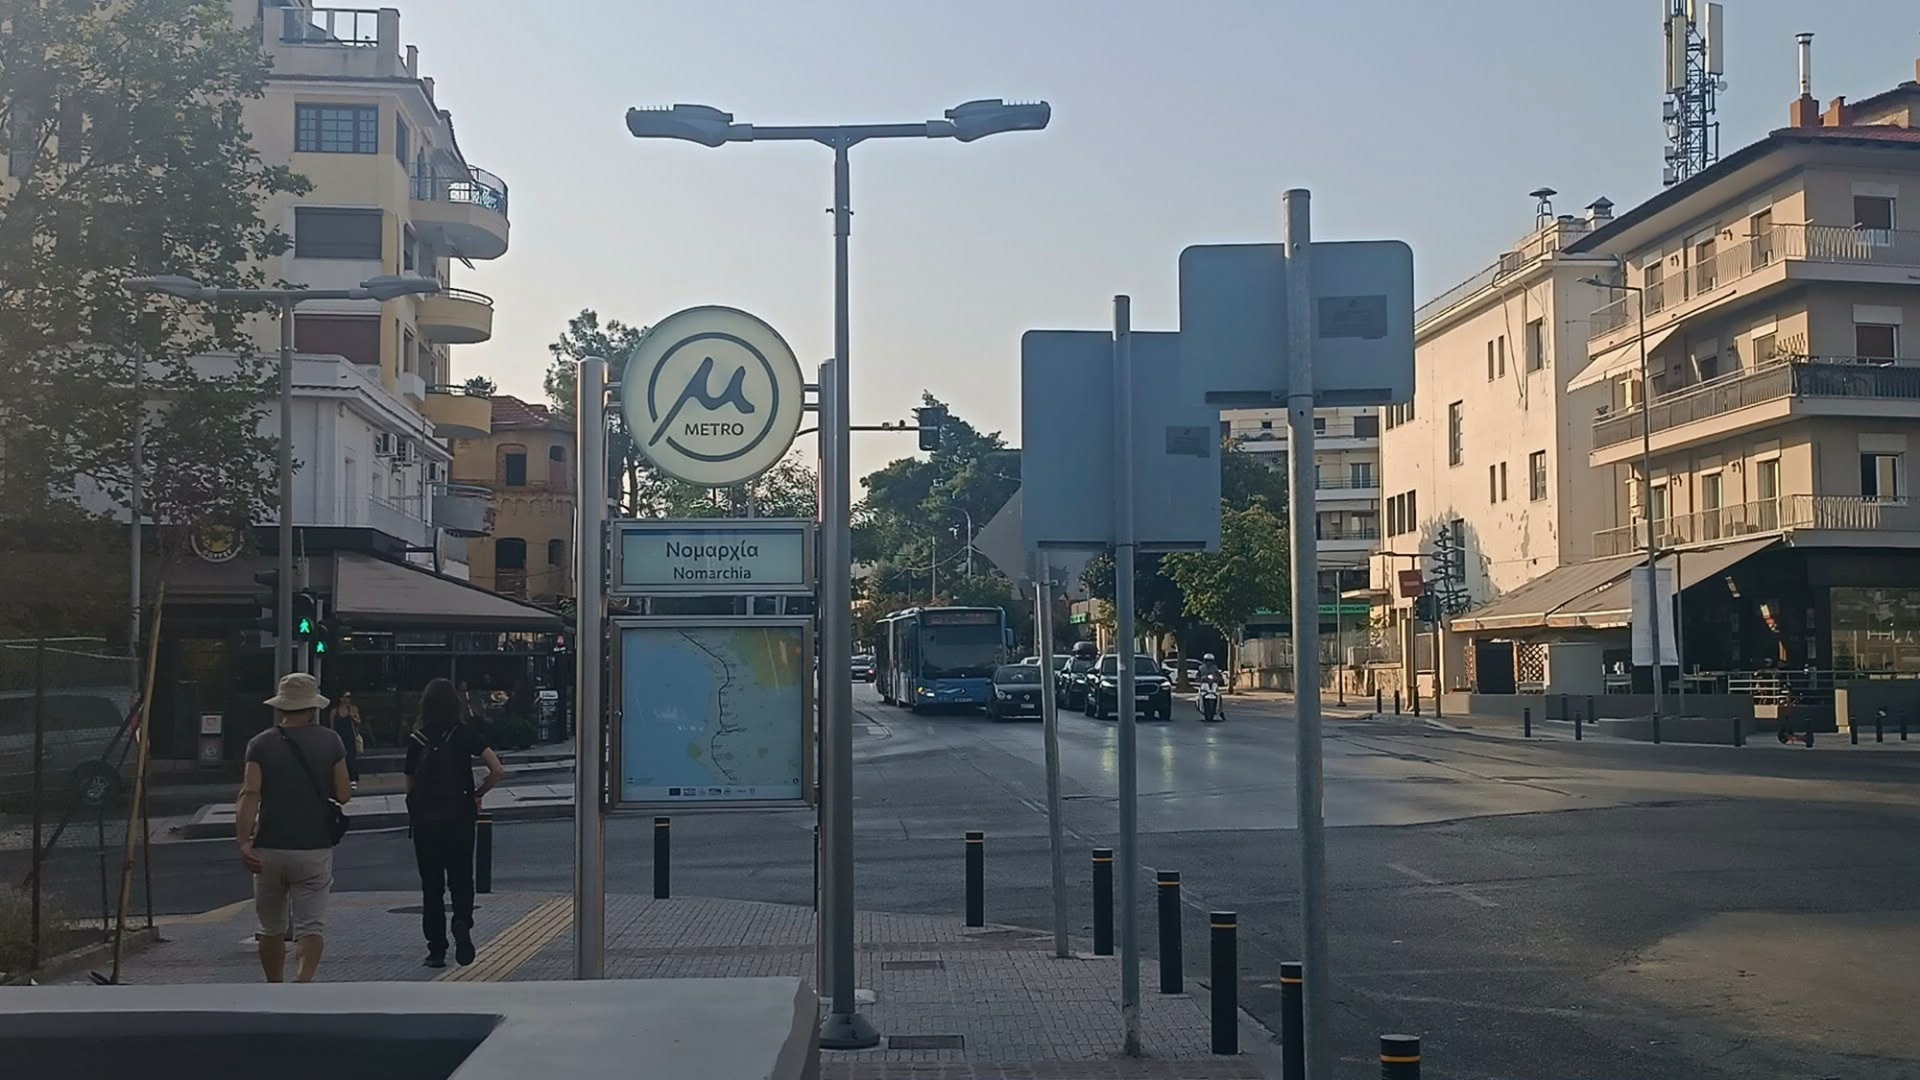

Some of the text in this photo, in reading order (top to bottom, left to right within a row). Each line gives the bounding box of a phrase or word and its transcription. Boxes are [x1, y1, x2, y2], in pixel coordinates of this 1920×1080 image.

[684, 422, 744, 437] METRO
[665, 540, 759, 561] Νομαρχία
[674, 566, 752, 580] Nomarchia
